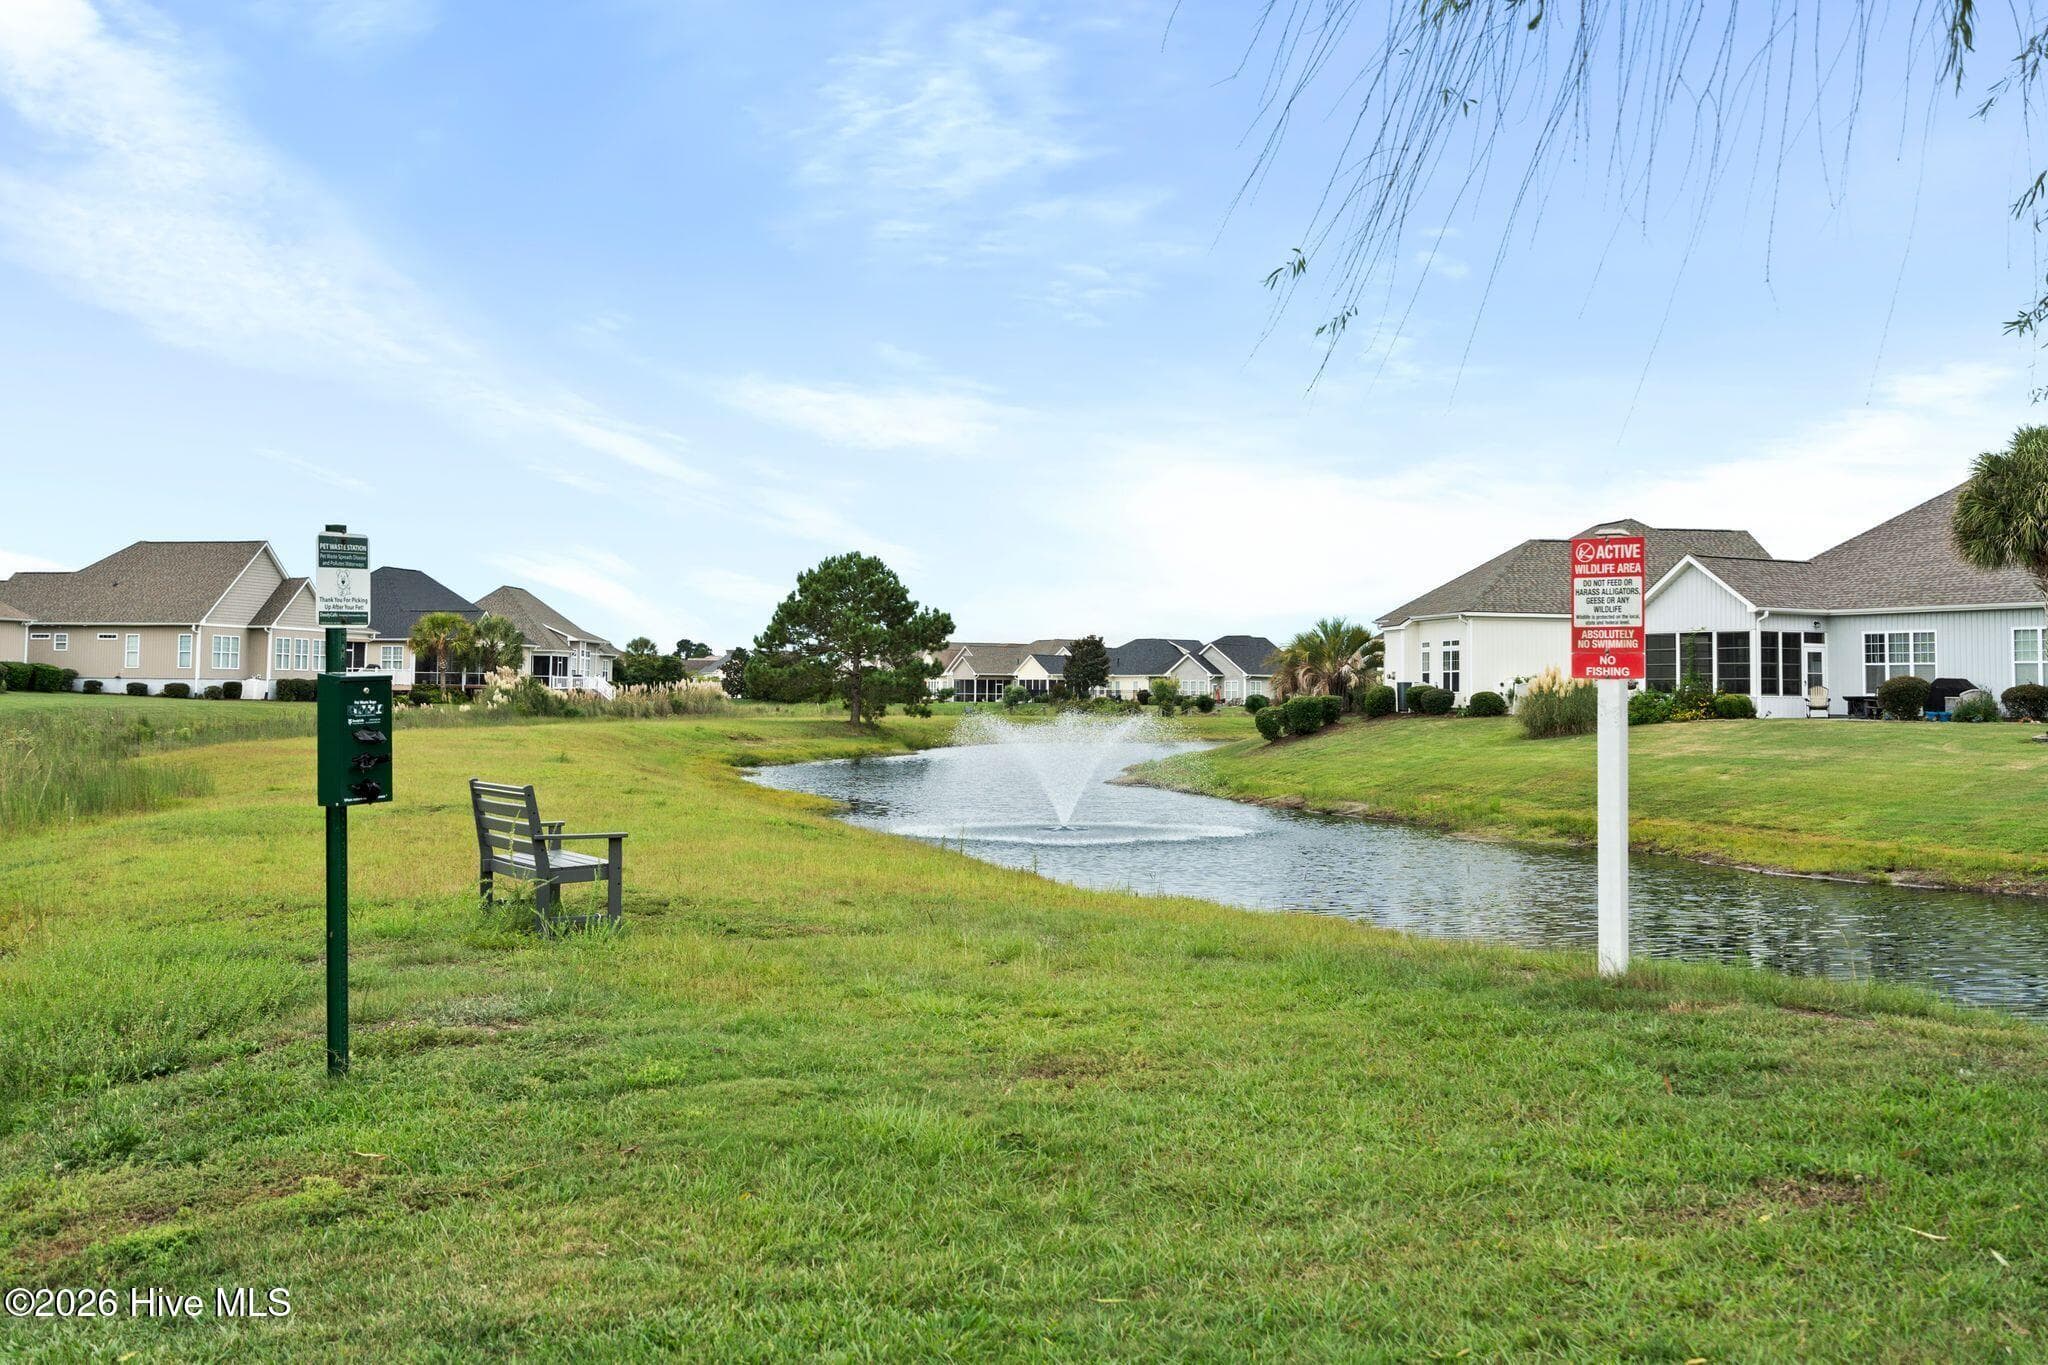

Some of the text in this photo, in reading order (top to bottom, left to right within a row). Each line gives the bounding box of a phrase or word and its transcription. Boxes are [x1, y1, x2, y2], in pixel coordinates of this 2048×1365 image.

[1596, 544, 1641, 560] ACTIVE
[1574, 562, 1642, 574] WILDLIFE AREA
[1601, 588, 1640, 596] ALLIGATORS,
[1582, 630, 1634, 639] ABSOLUTELY
[1578, 640, 1639, 648] NO SWIMMING
[1600, 655, 1616, 665] NO
[1586, 666, 1630, 676] FISHING
